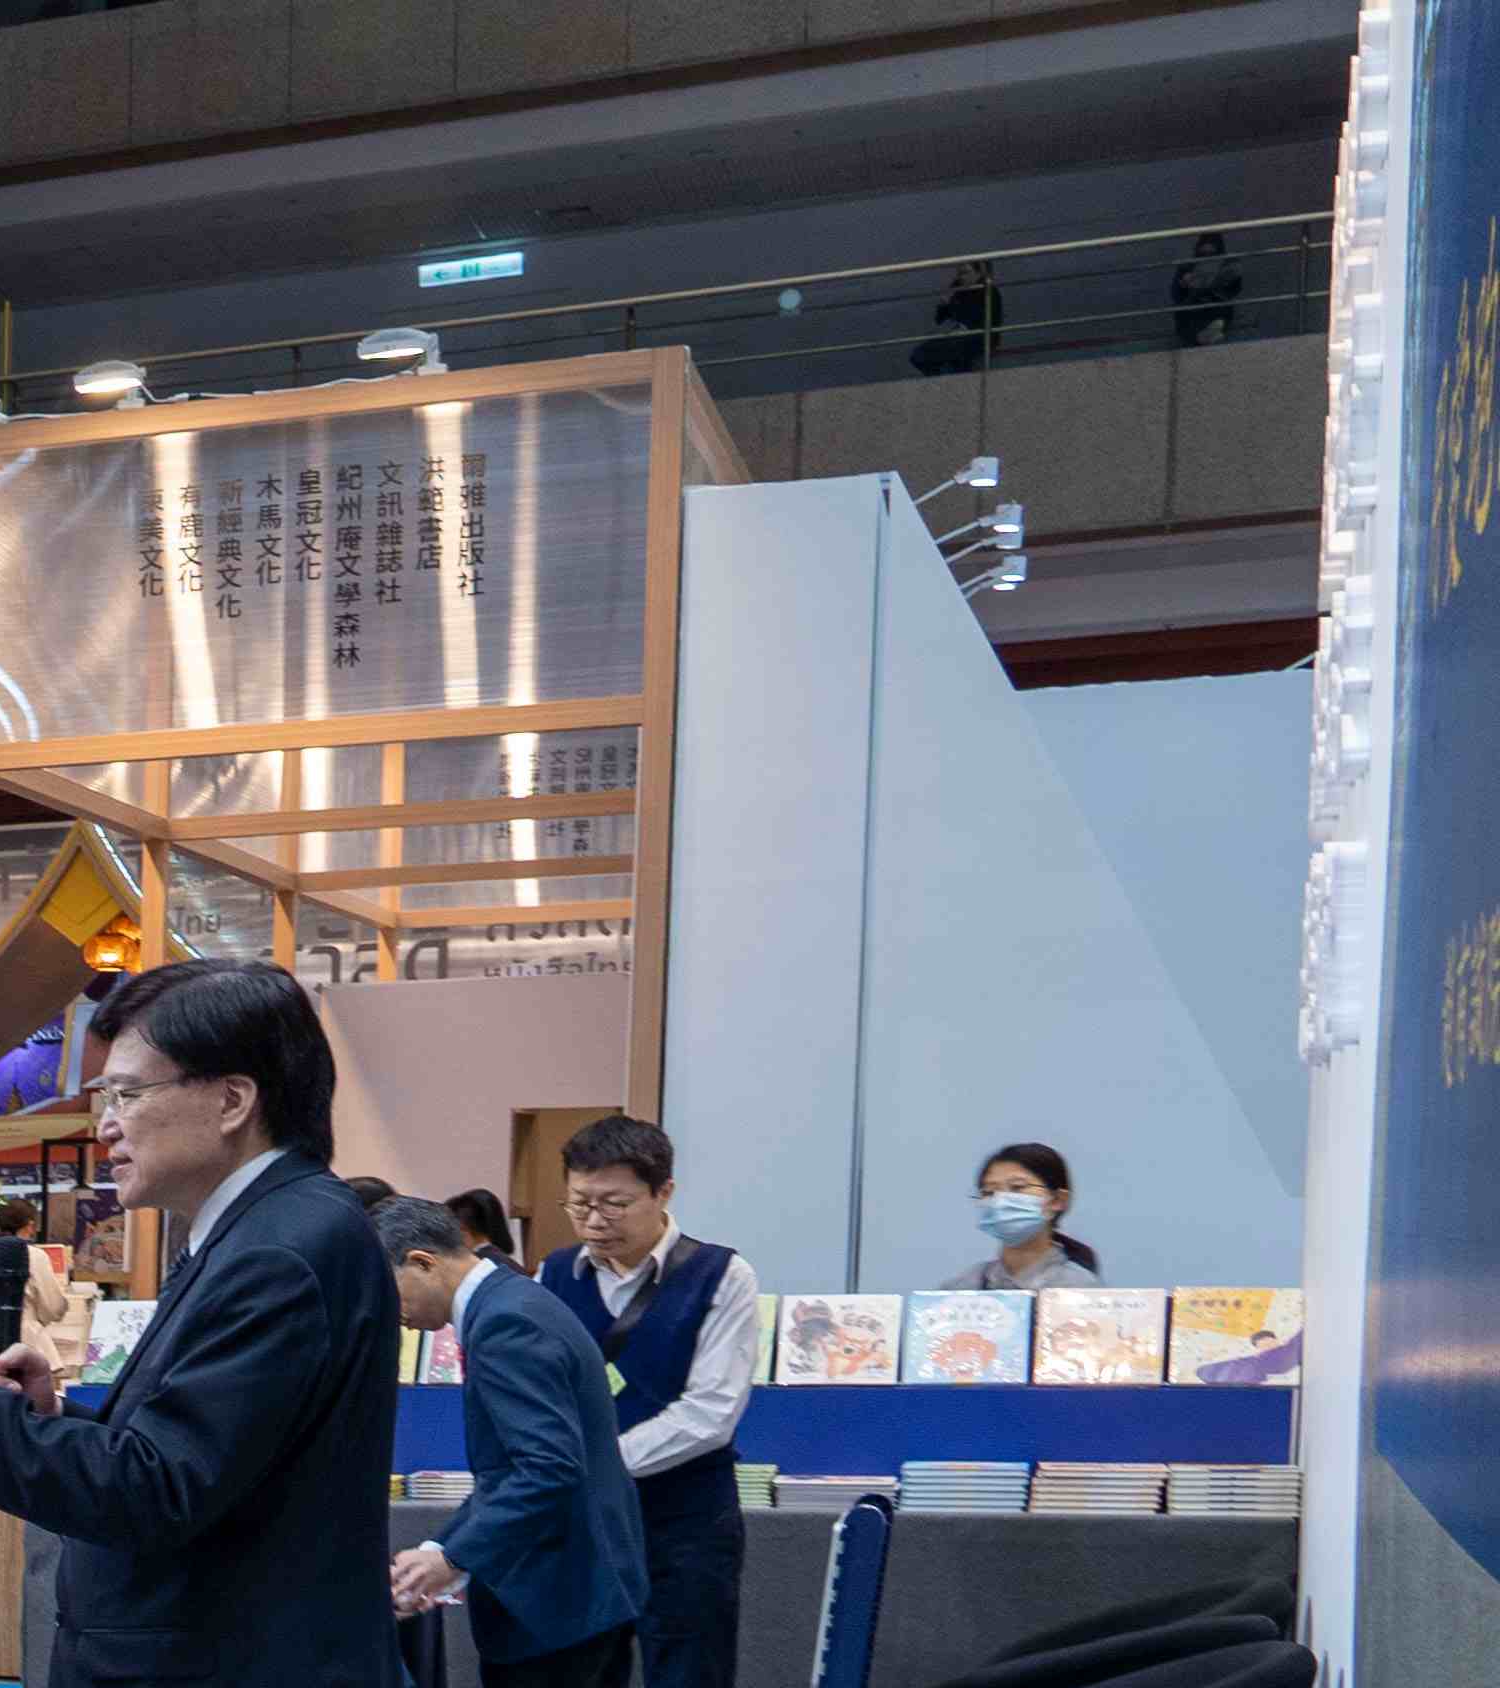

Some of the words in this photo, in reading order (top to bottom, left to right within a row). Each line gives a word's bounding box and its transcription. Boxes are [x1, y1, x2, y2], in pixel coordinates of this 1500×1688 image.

[255, 473, 283, 587] 木馬文化
[294, 469, 324, 583] 皇冠文化
[332, 464, 365, 670] 紀州庵文學森林
[374, 460, 404, 606] 文訊雜誌社
